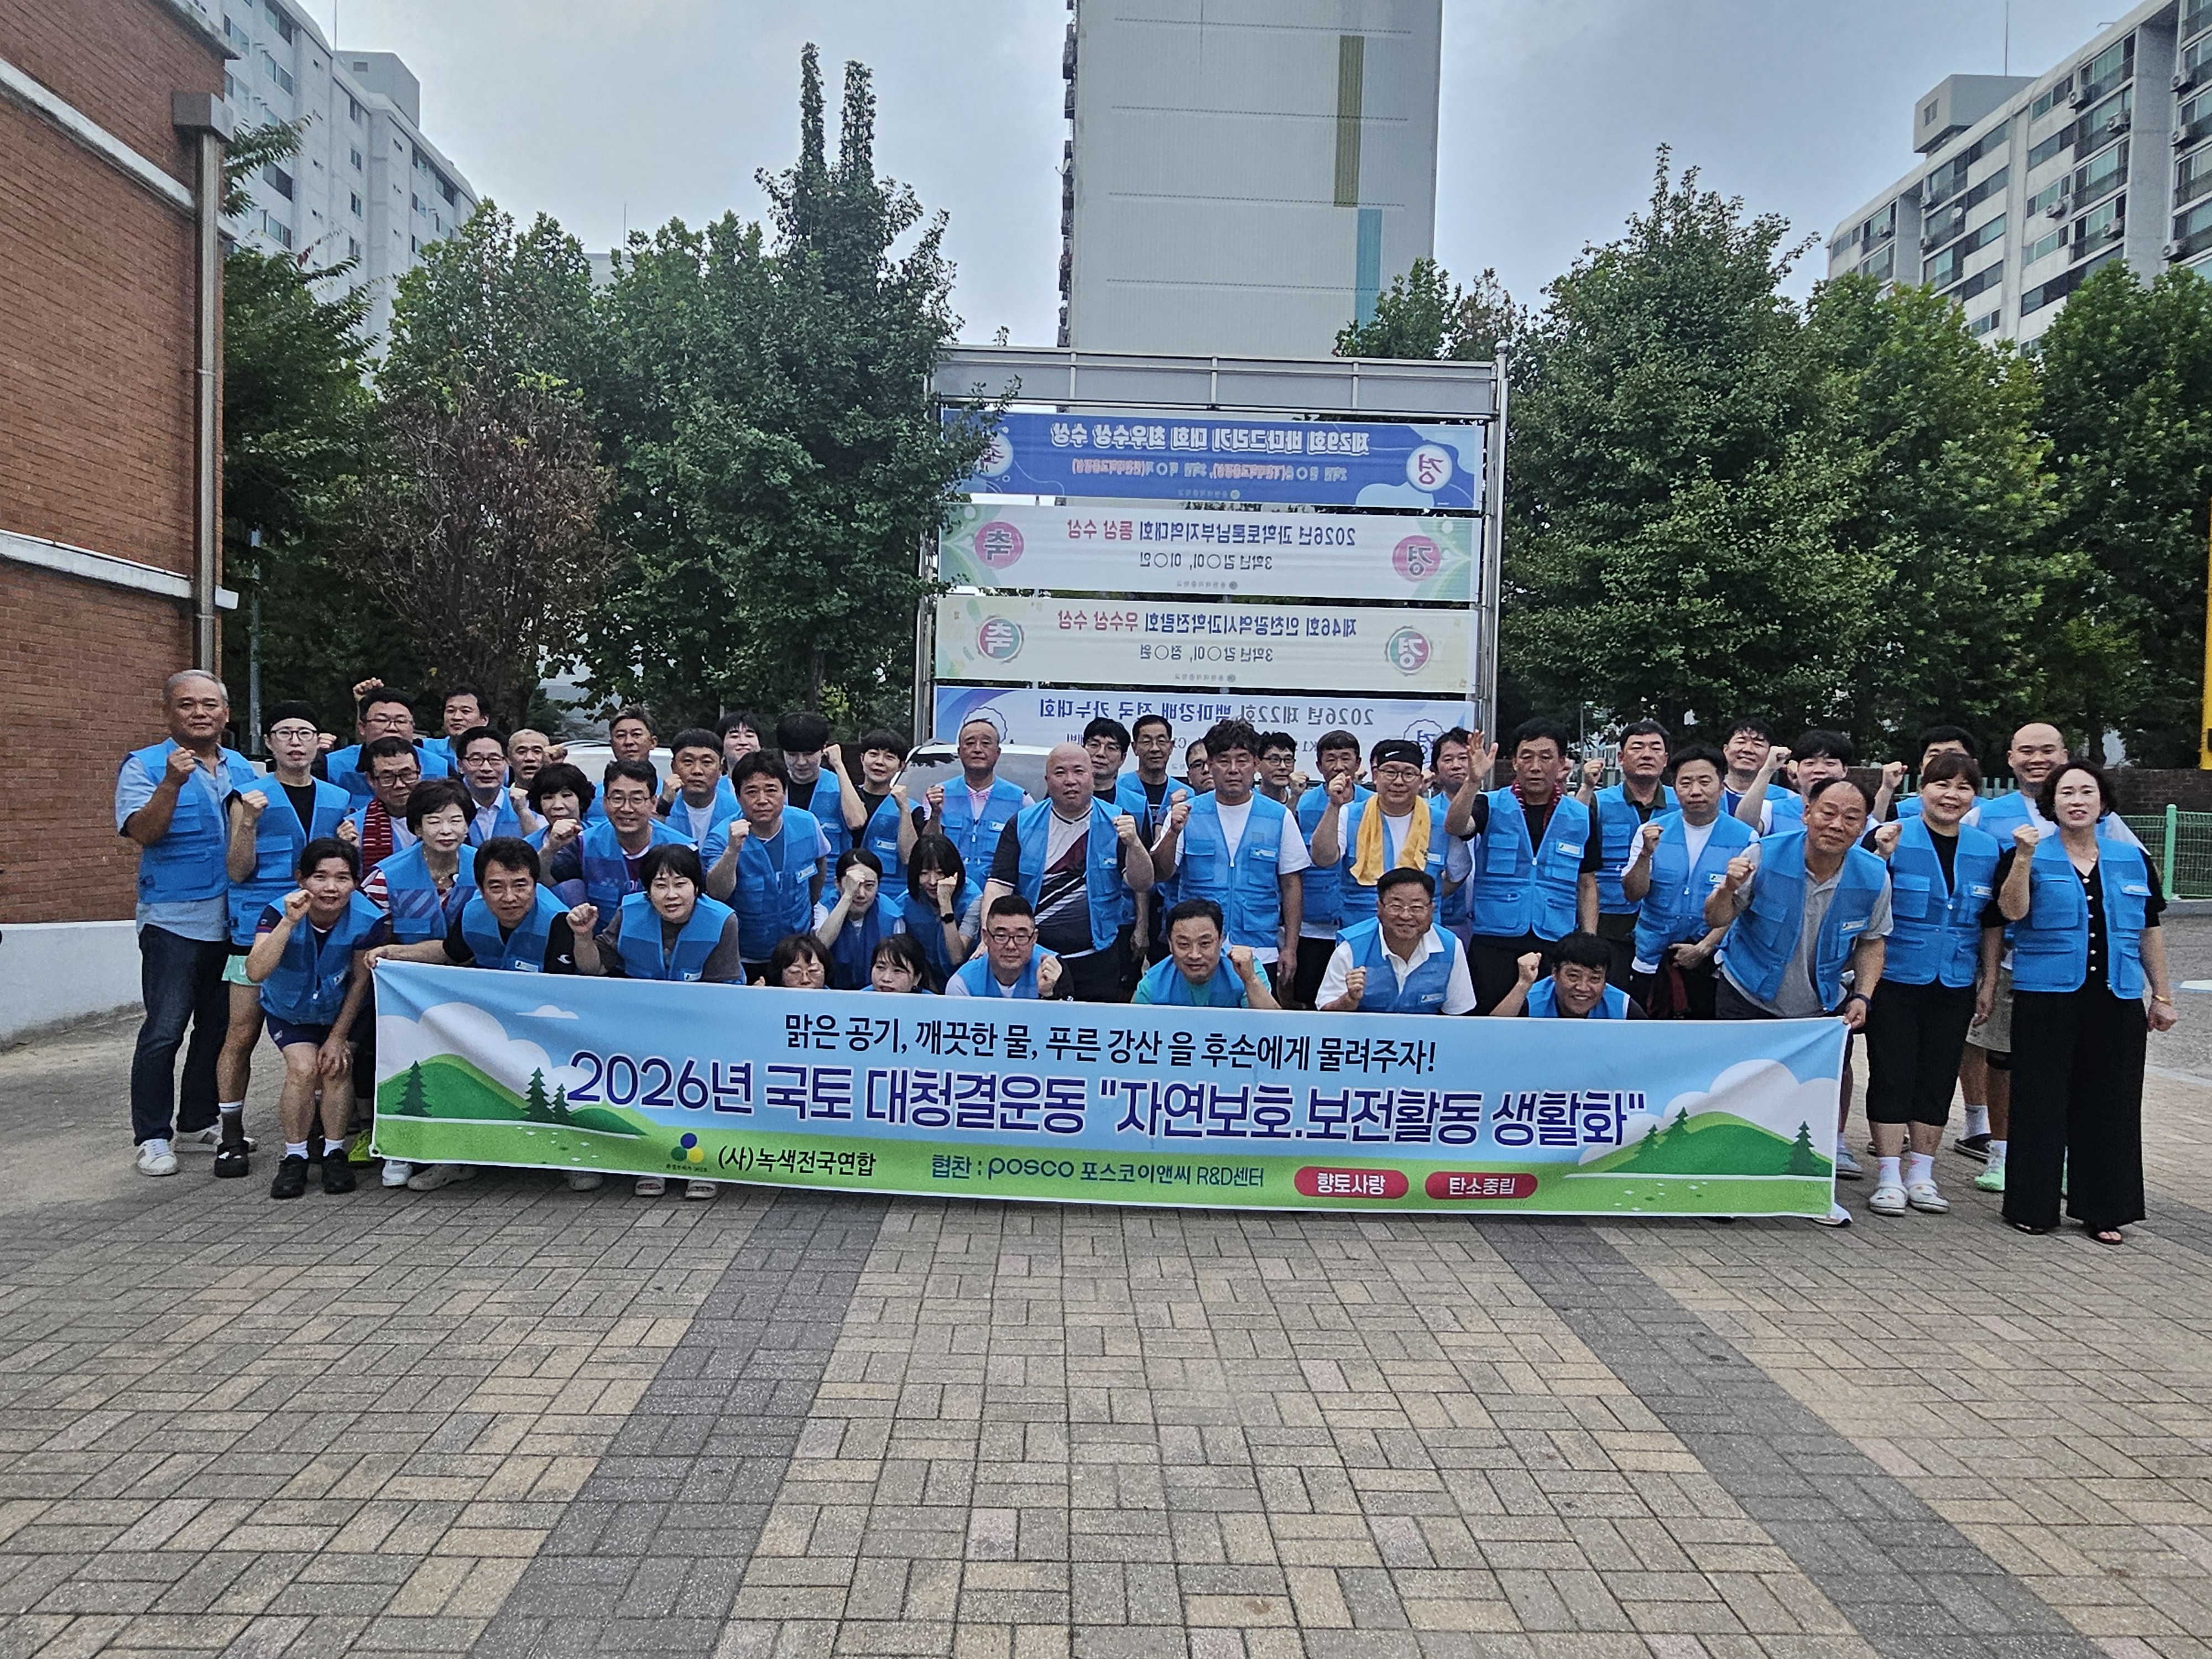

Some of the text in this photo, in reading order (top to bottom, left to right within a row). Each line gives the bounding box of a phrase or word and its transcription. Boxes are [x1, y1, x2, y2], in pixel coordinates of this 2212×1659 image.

[785, 1014, 1436, 1074] 맑은 공기, 깨끗한 물, 푸른 강산 을 후손에게 물려주자!
[567, 1051, 1645, 1148] 2026년 국토 대청결운동 "자연보호.보전활동 생활화"
[718, 1145, 877, 1176] (사)녹색전국연합
[932, 1154, 972, 1179] 협찬
[988, 1156, 1074, 1180] posco
[1080, 1161, 1191, 1185] 포스코이앤씨
[1197, 1166, 1264, 1187] R&D센터
[1317, 1172, 1386, 1195] 향토사랑
[1448, 1176, 1515, 1196] 탄소중립
